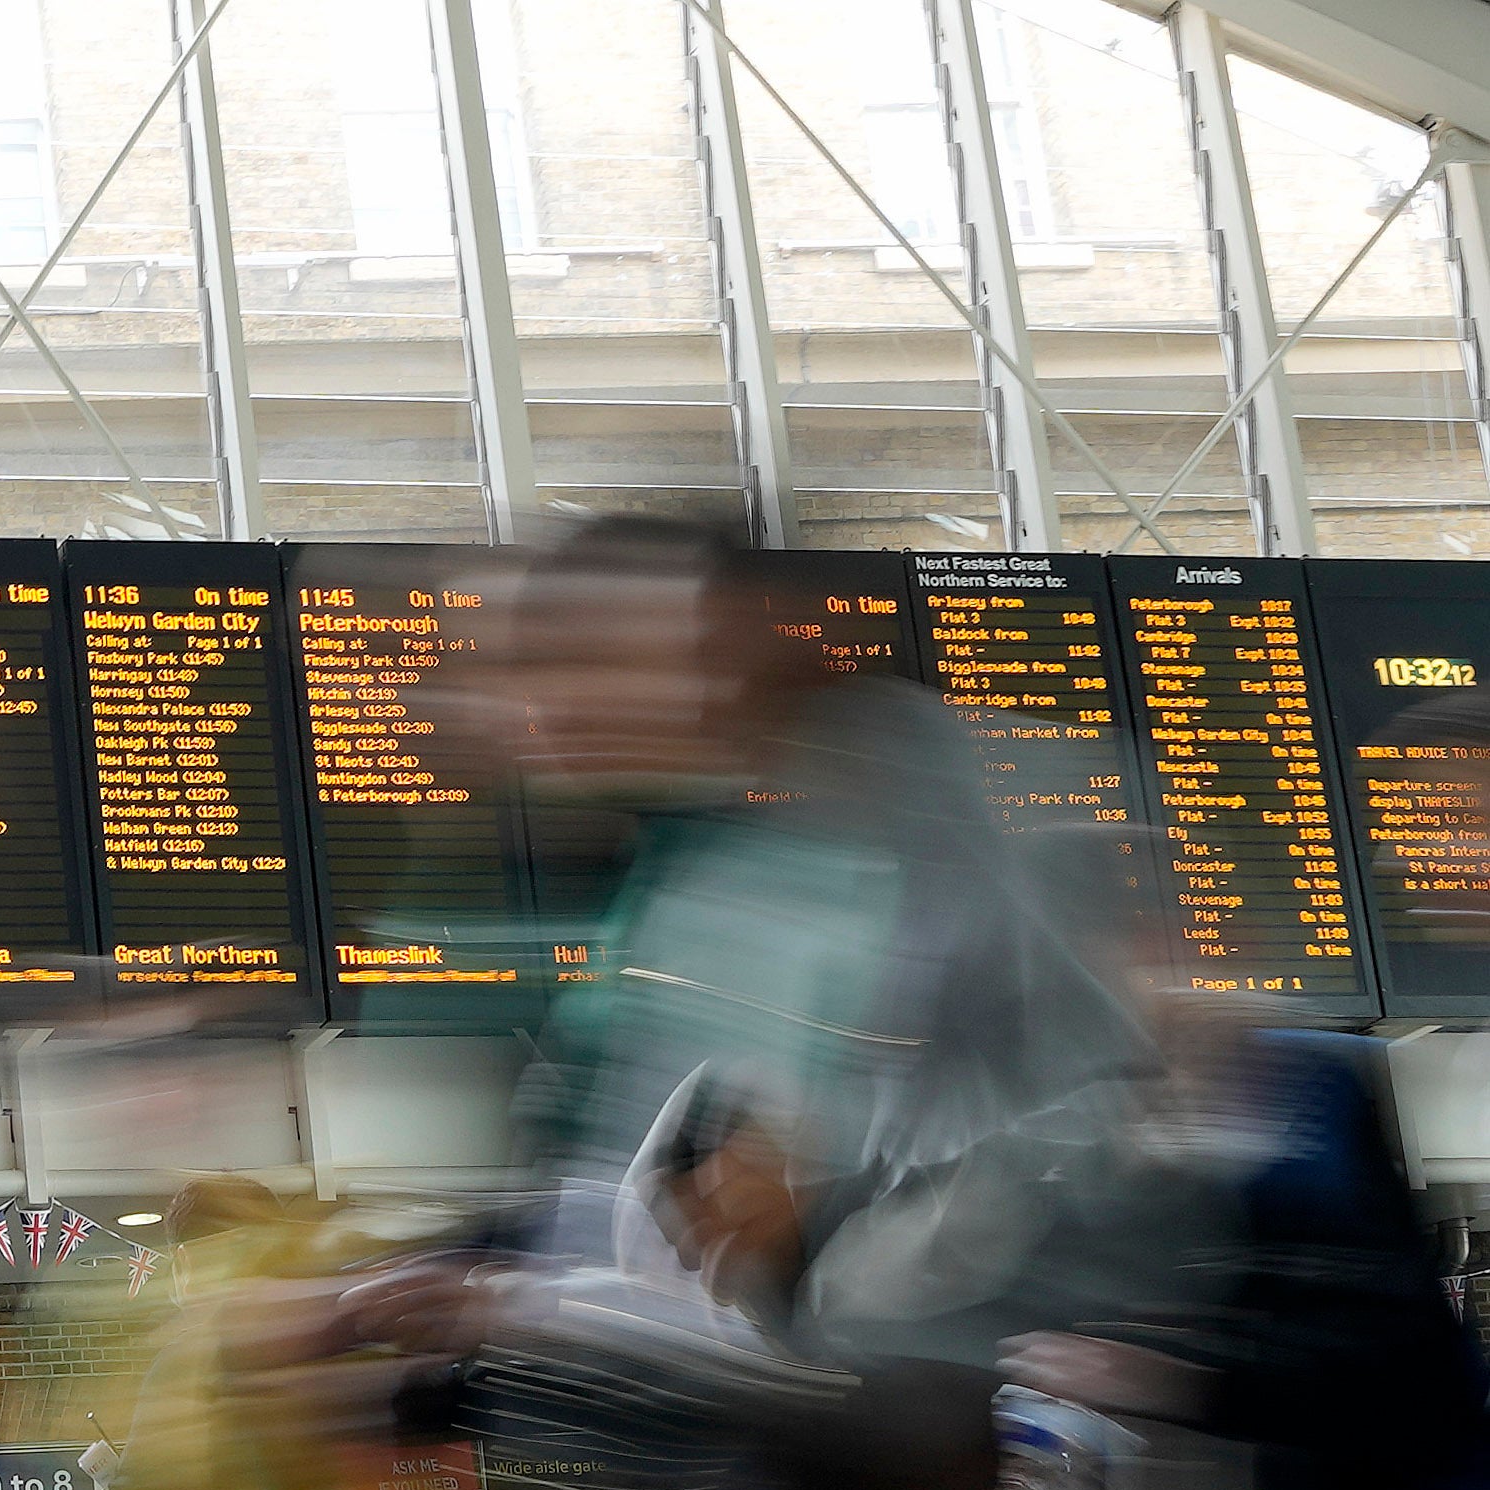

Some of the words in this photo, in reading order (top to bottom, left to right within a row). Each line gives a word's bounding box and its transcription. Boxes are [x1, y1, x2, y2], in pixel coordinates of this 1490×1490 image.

[915, 556, 950, 571] Next
[952, 557, 1007, 572] Fastest
[1009, 557, 1051, 572] Great
[918, 573, 985, 588] Northern
[987, 574, 1043, 588] Service
[1046, 575, 1068, 589] to:
[1175, 566, 1243, 585] Arrivals
[7, 585, 50, 603] time
[84, 585, 140, 605] 11:36
[194, 587, 221, 606] On
[227, 588, 269, 607] time
[299, 588, 355, 608] 11:45
[407, 590, 435, 608] On
[442, 591, 482, 608] time
[826, 597, 851, 613] On
[857, 597, 897, 614] time
[83, 612, 147, 630] Welwyn
[151, 612, 216, 631] Garden
[221, 612, 259, 631] City
[299, 613, 439, 634] Peterborough
[932, 628, 990, 641] Baldock
[994, 628, 1029, 641] from
[1012, 728, 1060, 739] Market
[1064, 727, 1100, 739] from
[1406, 747, 1449, 759] ADVICE
[1452, 748, 1468, 759] TO
[1368, 779, 1432, 792] Departure
[1028, 793, 1062, 805] Park
[1067, 793, 1102, 805] from
[1381, 812, 1440, 827] departing
[1167, 826, 1189, 841] Ely
[1370, 829, 1453, 842] Peterborough
[1396, 845, 1446, 857] Pancras
[1179, 895, 1244, 908] Stevenage
[1183, 928, 1220, 940] Leeds
[114, 944, 172, 965] Great
[181, 945, 278, 965] Northern
[336, 946, 441, 966] Thameslink
[553, 945, 588, 963] Hull
[392, 1461, 416, 1475] ASK
[420, 1458, 440, 1473] ME
[493, 1460, 532, 1475] Wide
[535, 1458, 569, 1474] aisle
[572, 1461, 607, 1476] gate
